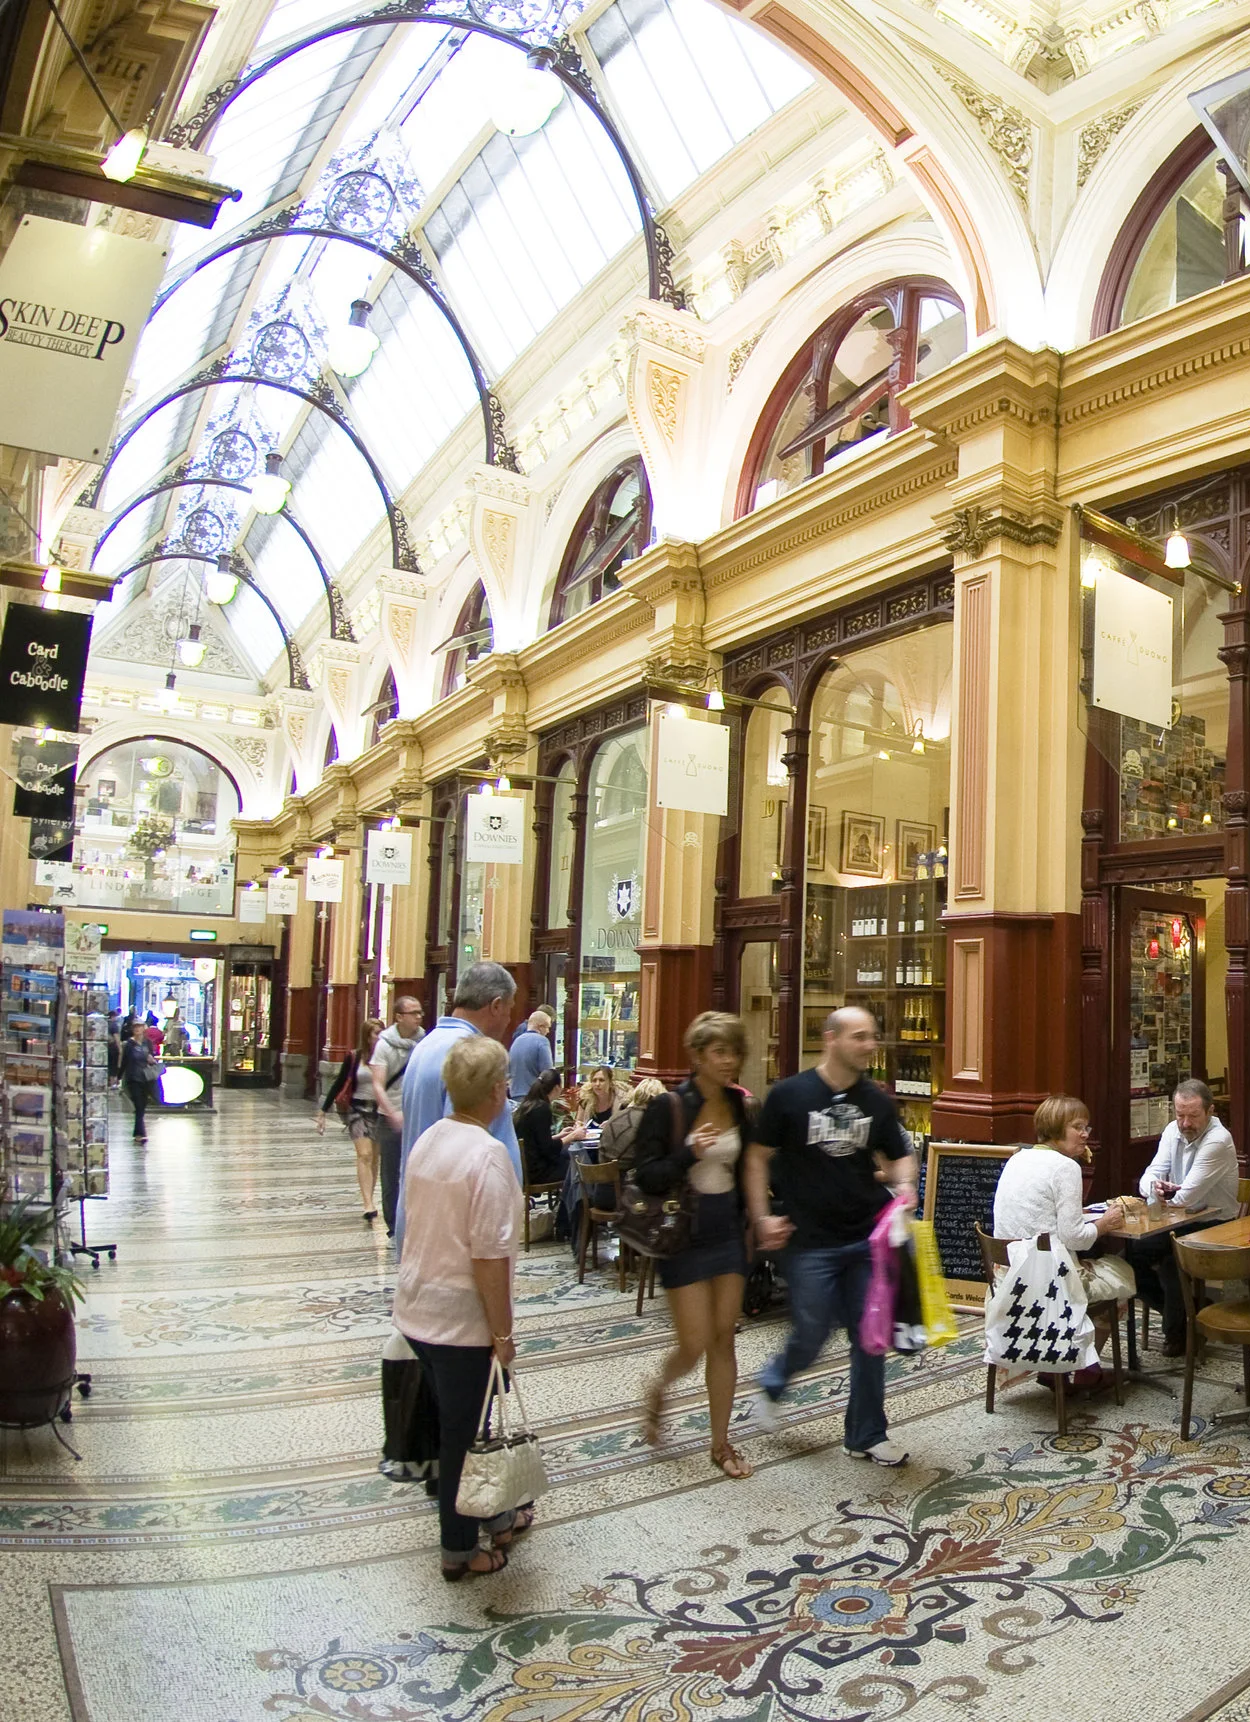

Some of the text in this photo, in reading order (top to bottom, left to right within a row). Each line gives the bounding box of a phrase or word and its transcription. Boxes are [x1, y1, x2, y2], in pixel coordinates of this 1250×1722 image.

[0, 298, 125, 361] SKIN DEEP
[6, 328, 94, 356] BEAUTY THERAPY
[28, 642, 59, 659] Card
[1139, 646, 1168, 663] DUOMO
[32, 656, 52, 678] &
[10, 671, 69, 691] Caboodle
[36, 762, 58, 774] Card
[25, 781, 65, 796] Caboodle
[474, 832, 518, 844] DOWNIES
[372, 860, 407, 870] DOWNIES
